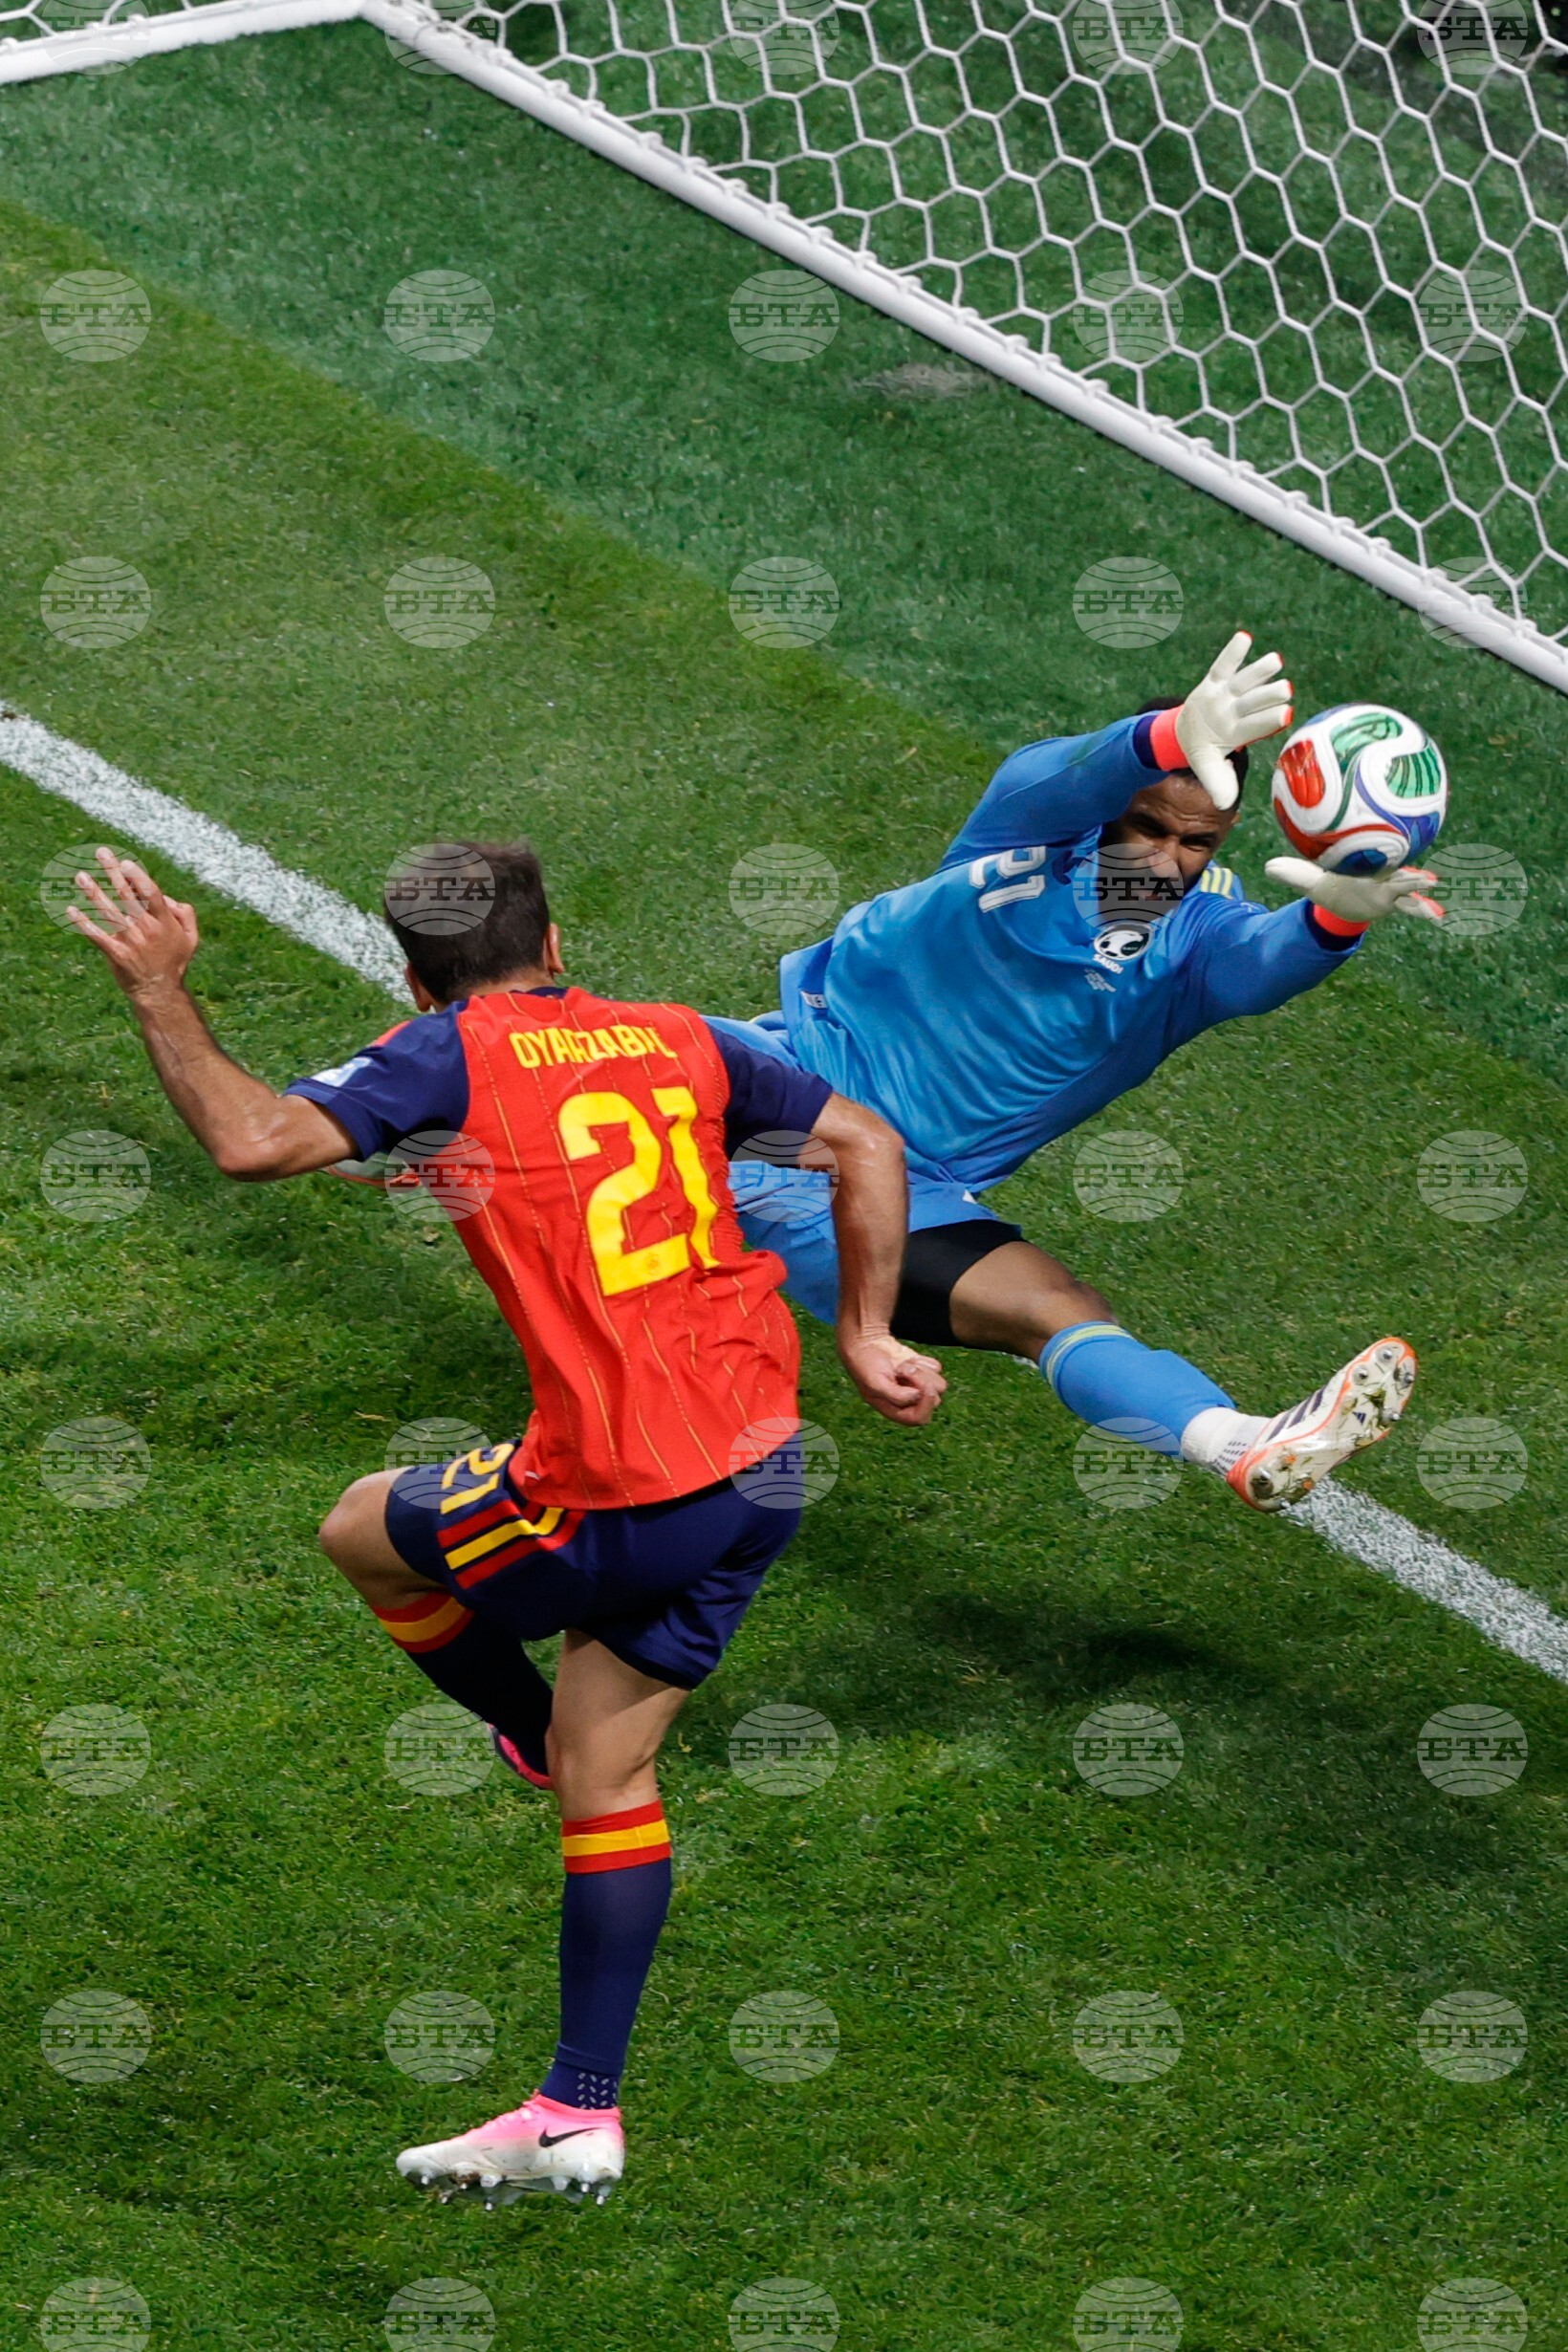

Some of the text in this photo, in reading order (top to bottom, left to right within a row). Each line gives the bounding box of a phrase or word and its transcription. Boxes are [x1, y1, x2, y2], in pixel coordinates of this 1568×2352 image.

[969, 846, 1047, 913] 21
[1093, 953, 1124, 974] SAUDI
[558, 1086, 721, 1296] 21
[441, 1443, 514, 1515] 21
